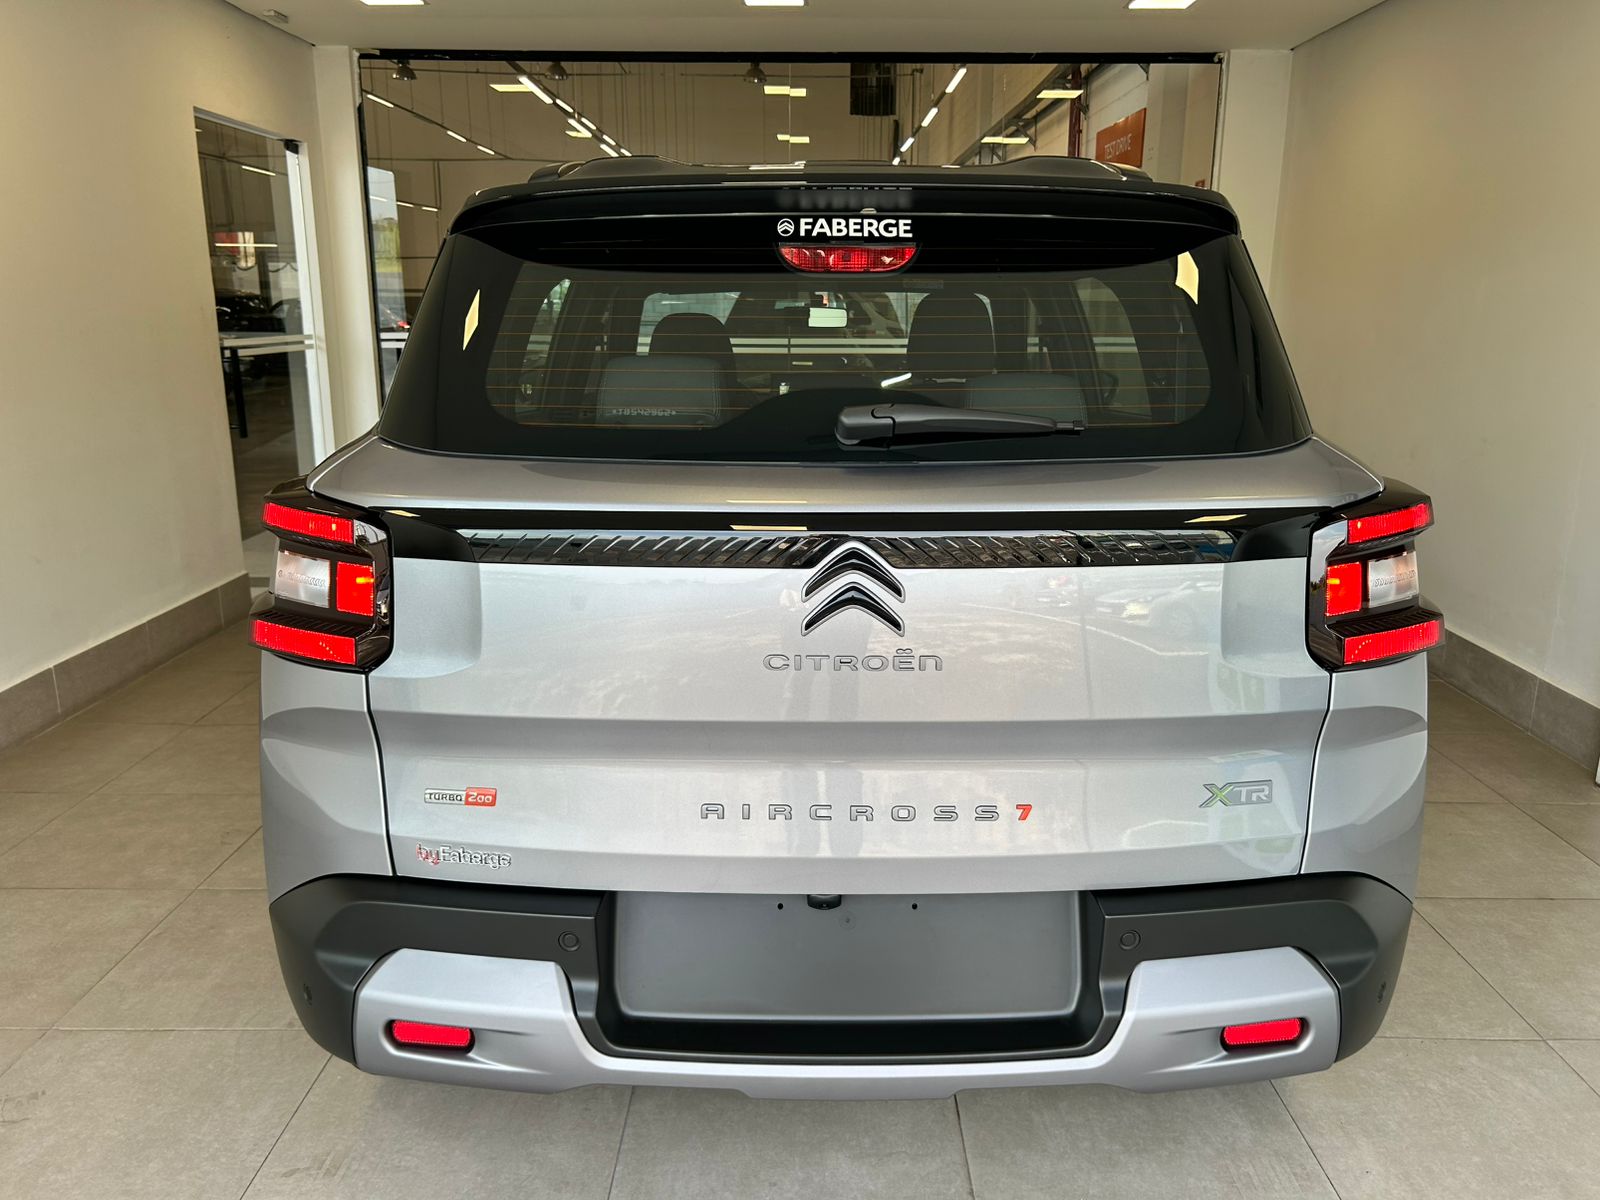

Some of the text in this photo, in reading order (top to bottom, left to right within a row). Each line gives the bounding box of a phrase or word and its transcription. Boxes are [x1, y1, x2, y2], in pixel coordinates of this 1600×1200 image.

[799, 217, 914, 238] FABERGE
[426, 791, 494, 804] TURBO 200
[1198, 779, 1273, 808] XTR
